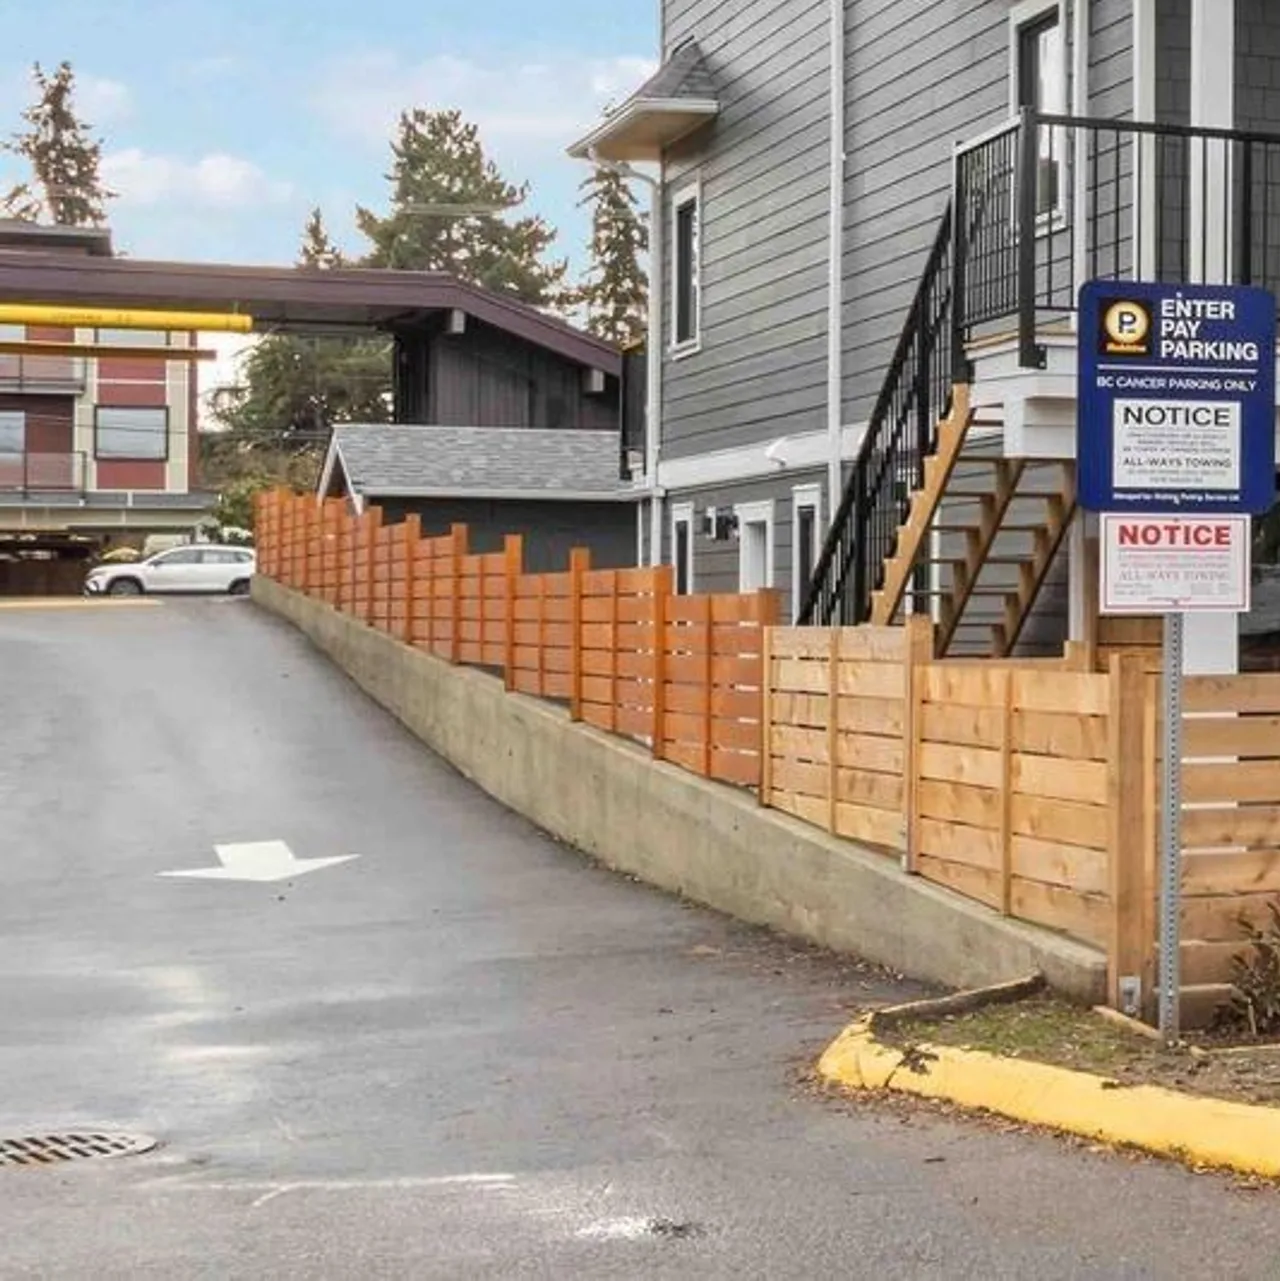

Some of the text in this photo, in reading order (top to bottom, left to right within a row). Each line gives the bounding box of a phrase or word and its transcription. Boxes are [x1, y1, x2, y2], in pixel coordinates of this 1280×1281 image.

[1161, 299, 1235, 320] ENTER
[1161, 320, 1201, 339] PAY
[1161, 340, 1259, 361] PARKING
[1097, 376, 1257, 391] BC CANCER PARKING ONLY
[1123, 406, 1231, 427] NOTICE
[1185, 458, 1232, 469] TOWING
[1118, 524, 1232, 546] NOTICE
